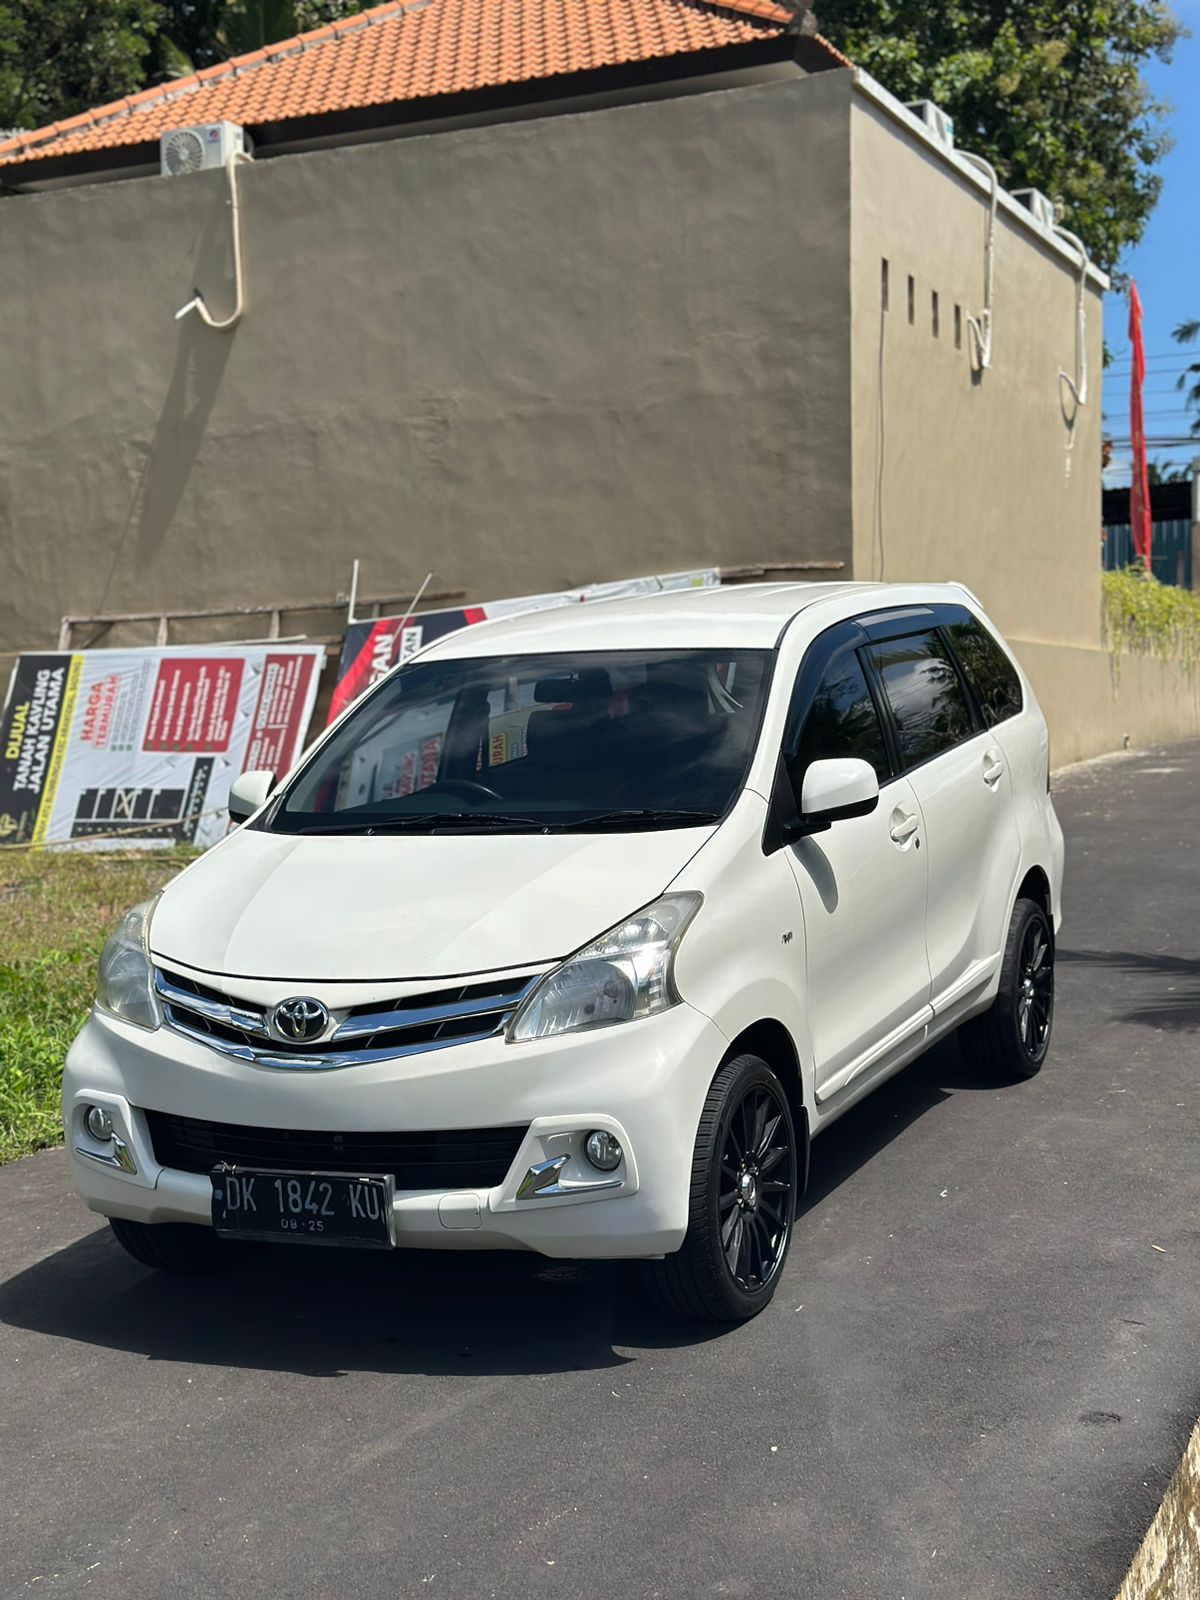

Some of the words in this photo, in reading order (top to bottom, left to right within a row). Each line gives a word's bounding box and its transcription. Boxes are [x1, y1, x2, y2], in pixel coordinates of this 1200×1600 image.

[5, 701, 31, 760] DIJUAL
[13, 737, 36, 791] TANAH
[26, 669, 50, 735] KAVLING
[27, 736, 52, 793] JALAN
[42, 667, 65, 731] UTAMA
[80, 682, 105, 742] HARGA
[95, 674, 119, 749] TERMURAH
[225, 1177, 257, 1212] DK
[274, 1178, 335, 1216] 1842
[349, 1183, 380, 1220] KU
